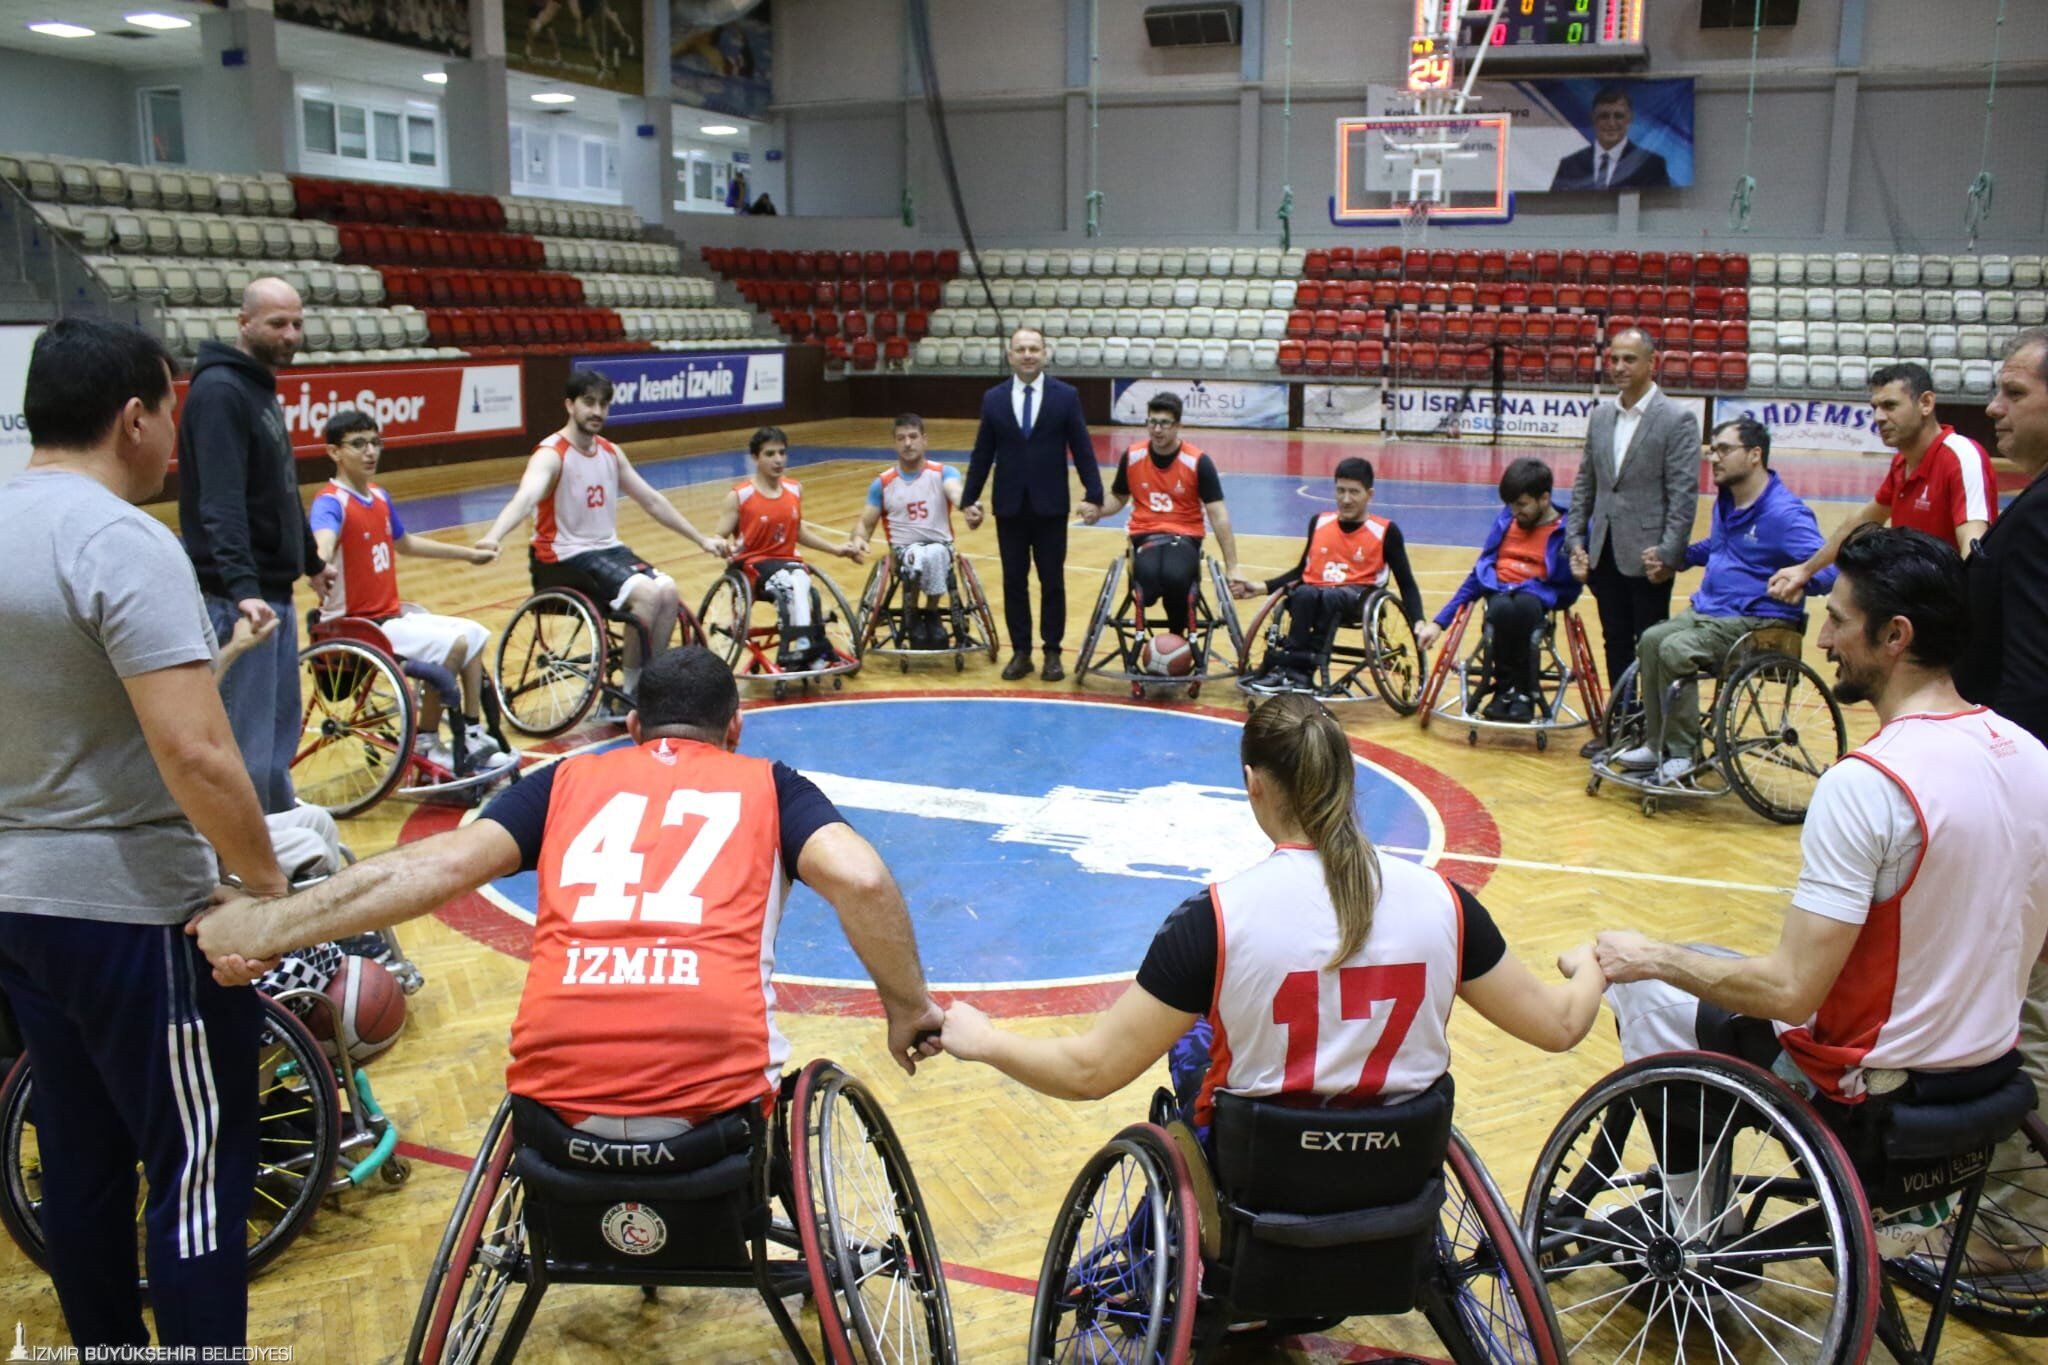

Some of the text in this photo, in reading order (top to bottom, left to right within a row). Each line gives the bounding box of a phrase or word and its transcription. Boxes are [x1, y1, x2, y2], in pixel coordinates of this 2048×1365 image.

[1567, 22, 1582, 43] 0
[1408, 58, 1450, 91] 24
[639, 371, 686, 402] kenti
[686, 362, 733, 398] İZMİR
[1218, 393, 1246, 409] SU
[1544, 398, 1593, 418] HAY
[587, 485, 604, 508] 23
[1149, 492, 1173, 512] 53
[906, 500, 929, 521] 55
[372, 541, 390, 573] 20
[559, 788, 742, 925] 47
[561, 938, 700, 985] İZMİR
[1272, 962, 1427, 1105] 17
[568, 1137, 675, 1167] EXTRA
[1300, 1130, 1400, 1151] EXTRA
